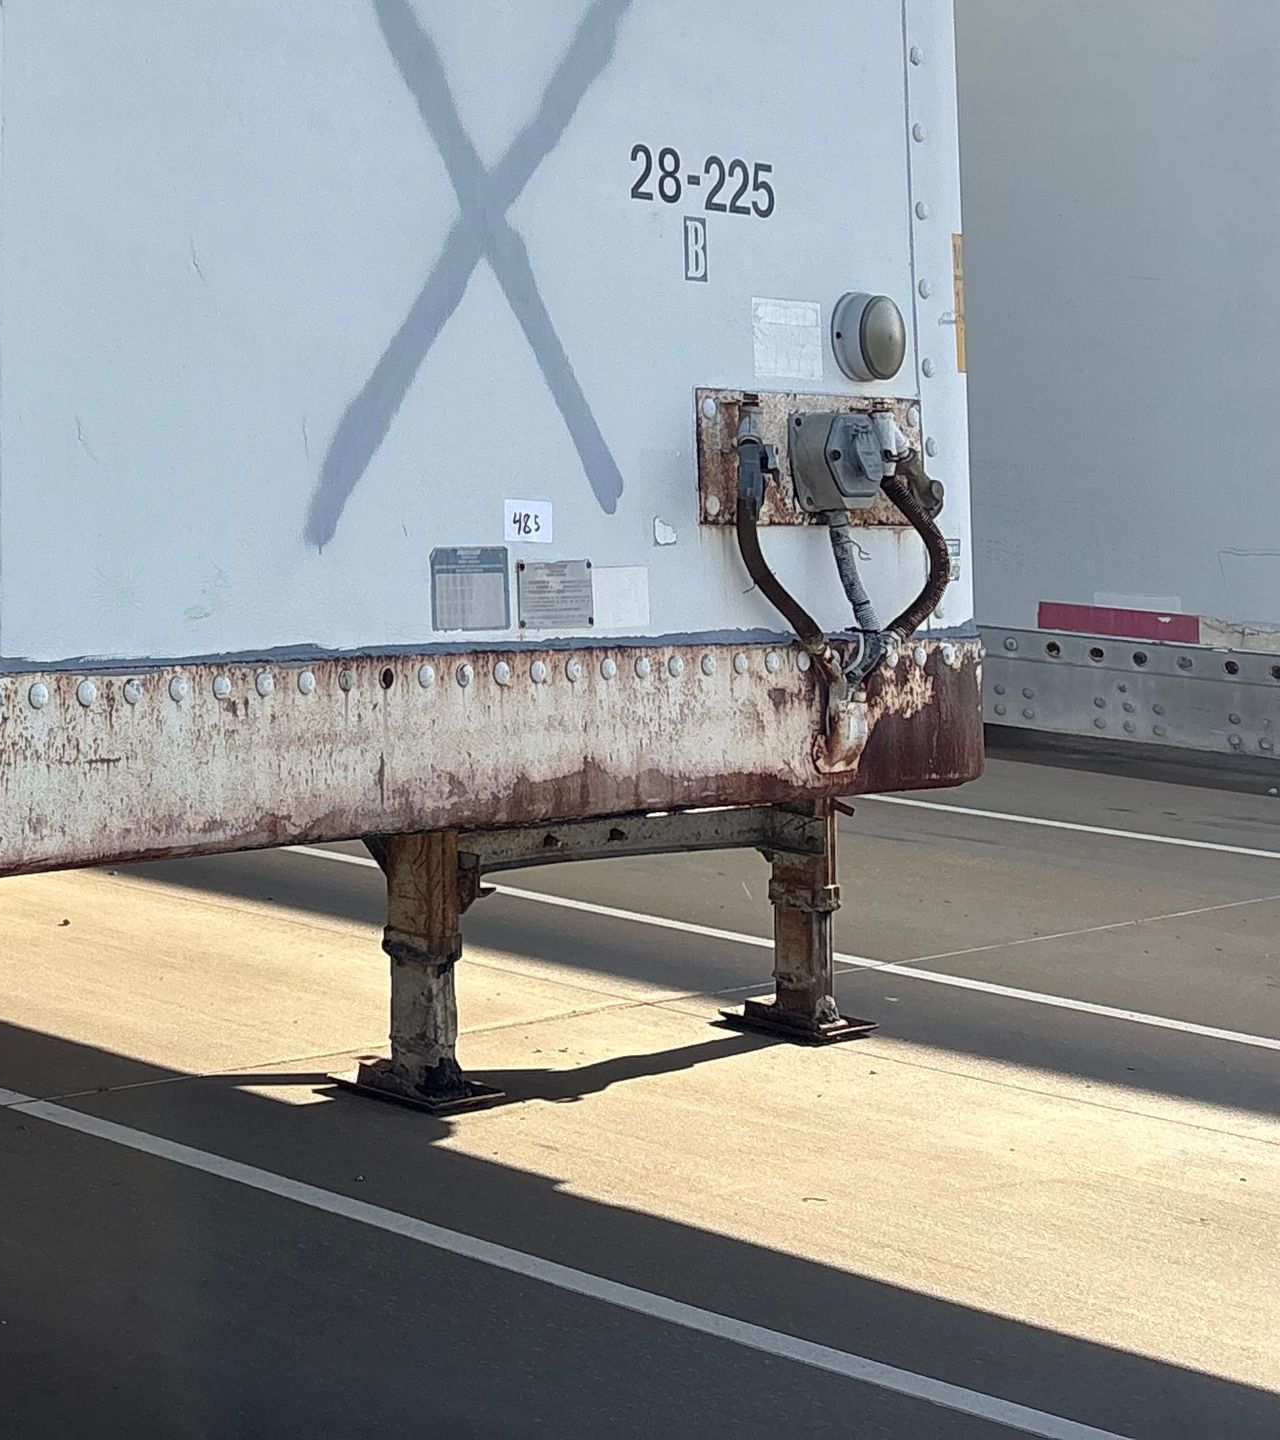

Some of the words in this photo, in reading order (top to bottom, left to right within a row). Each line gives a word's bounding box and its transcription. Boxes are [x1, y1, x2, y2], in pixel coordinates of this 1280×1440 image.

[631, 144, 774, 218] 28-225
[686, 219, 707, 280] B
[513, 512, 541, 535] 485
